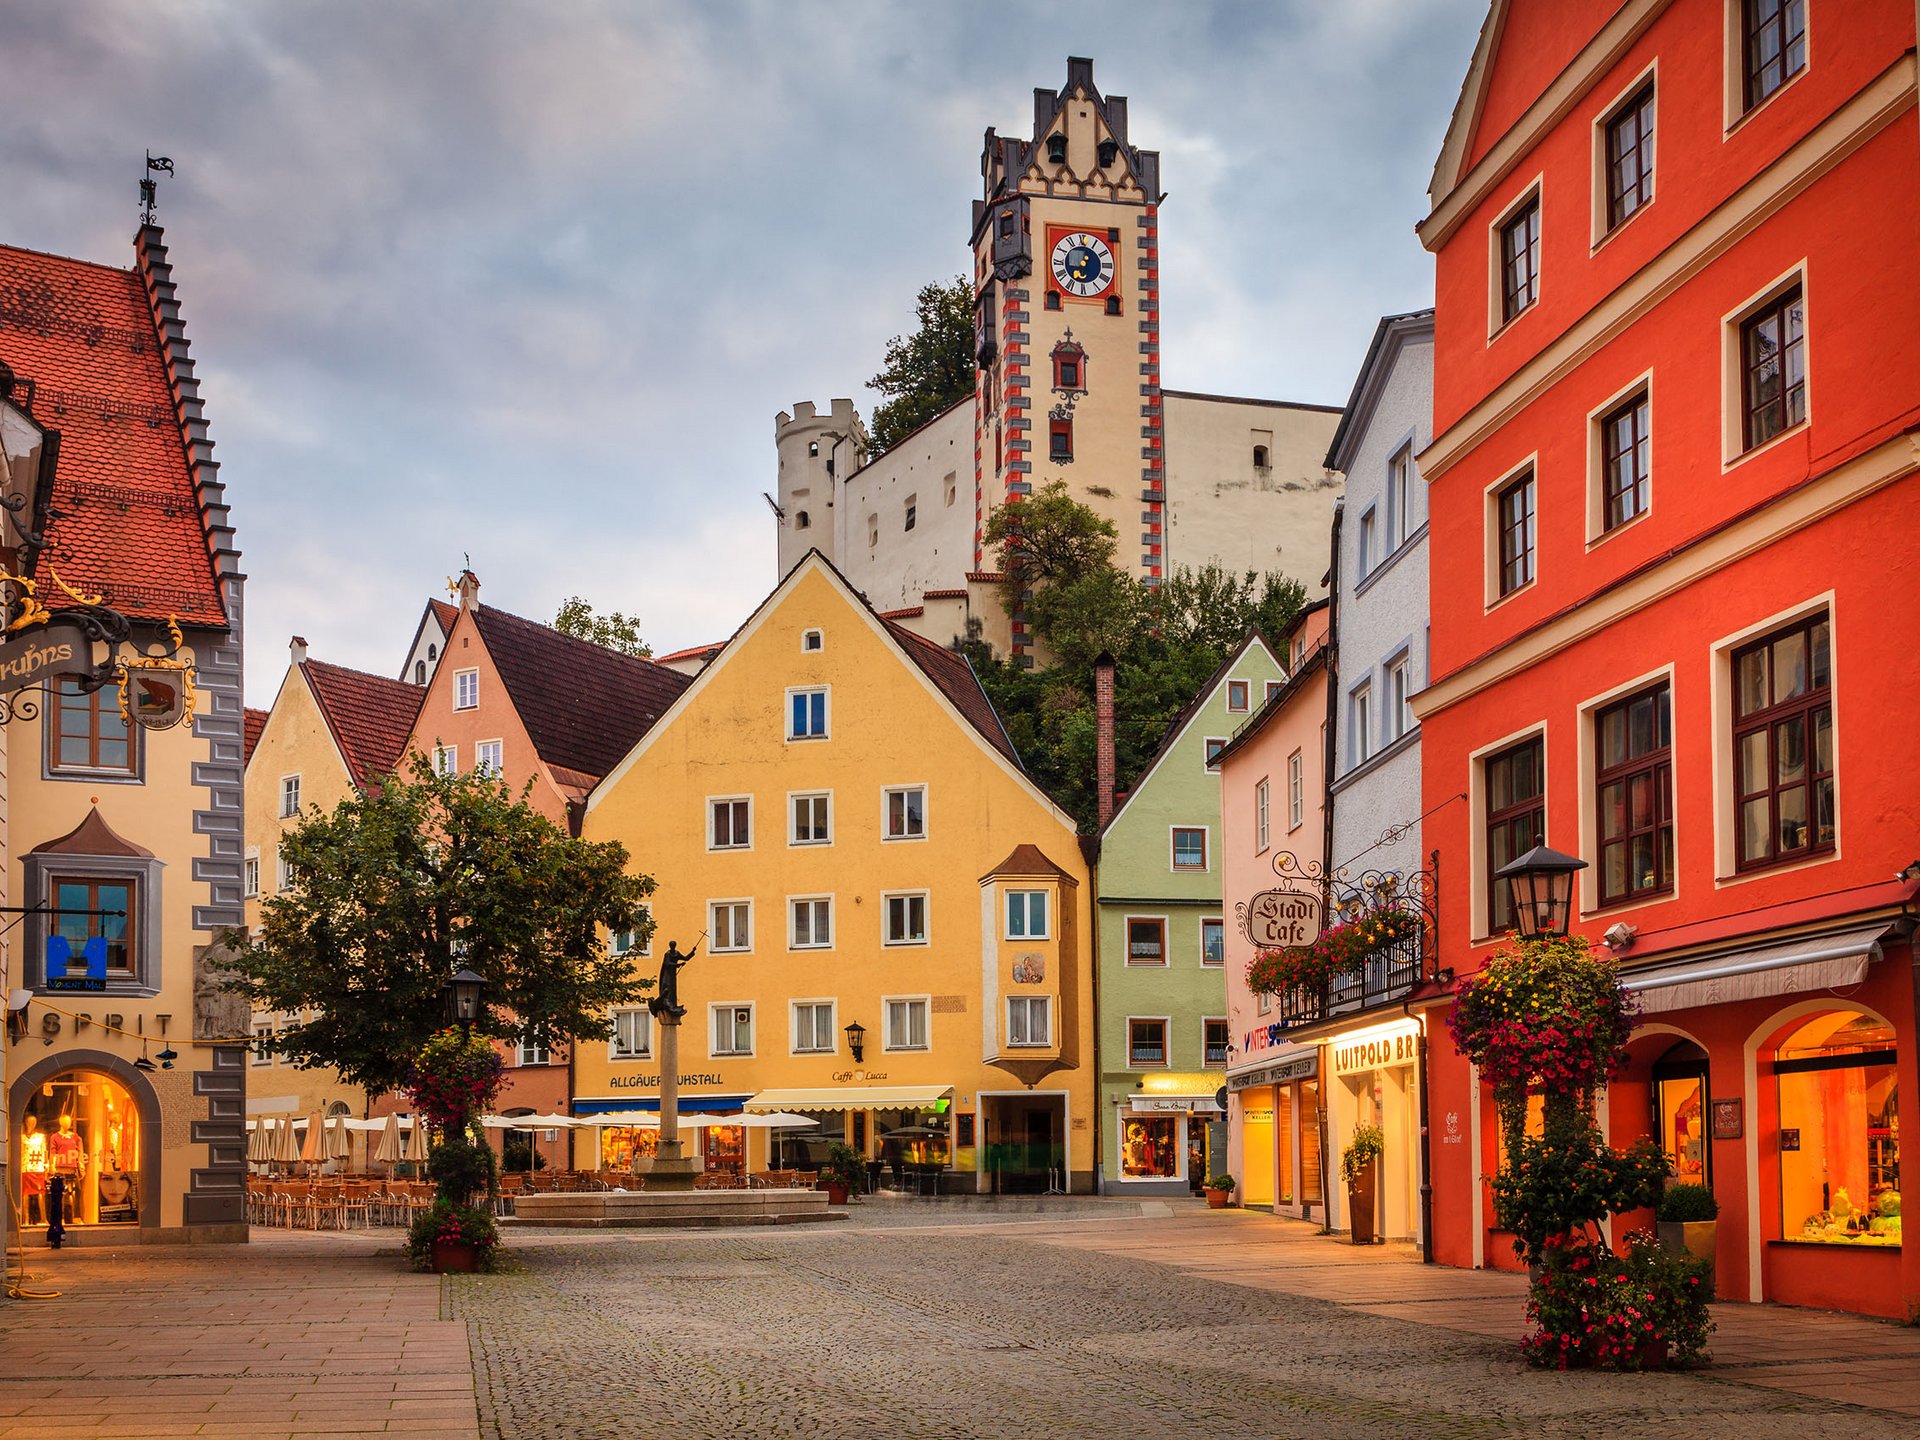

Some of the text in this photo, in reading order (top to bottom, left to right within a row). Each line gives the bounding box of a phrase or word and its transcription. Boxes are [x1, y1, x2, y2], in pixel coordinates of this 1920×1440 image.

[1254, 895, 1315, 920] Stadt
[43, 1012, 172, 1035] SPRIT
[1335, 1039, 1391, 1072] LUITPOLD
[676, 1074, 724, 1086] UHSTALL
[865, 1071, 888, 1080] Lucca
